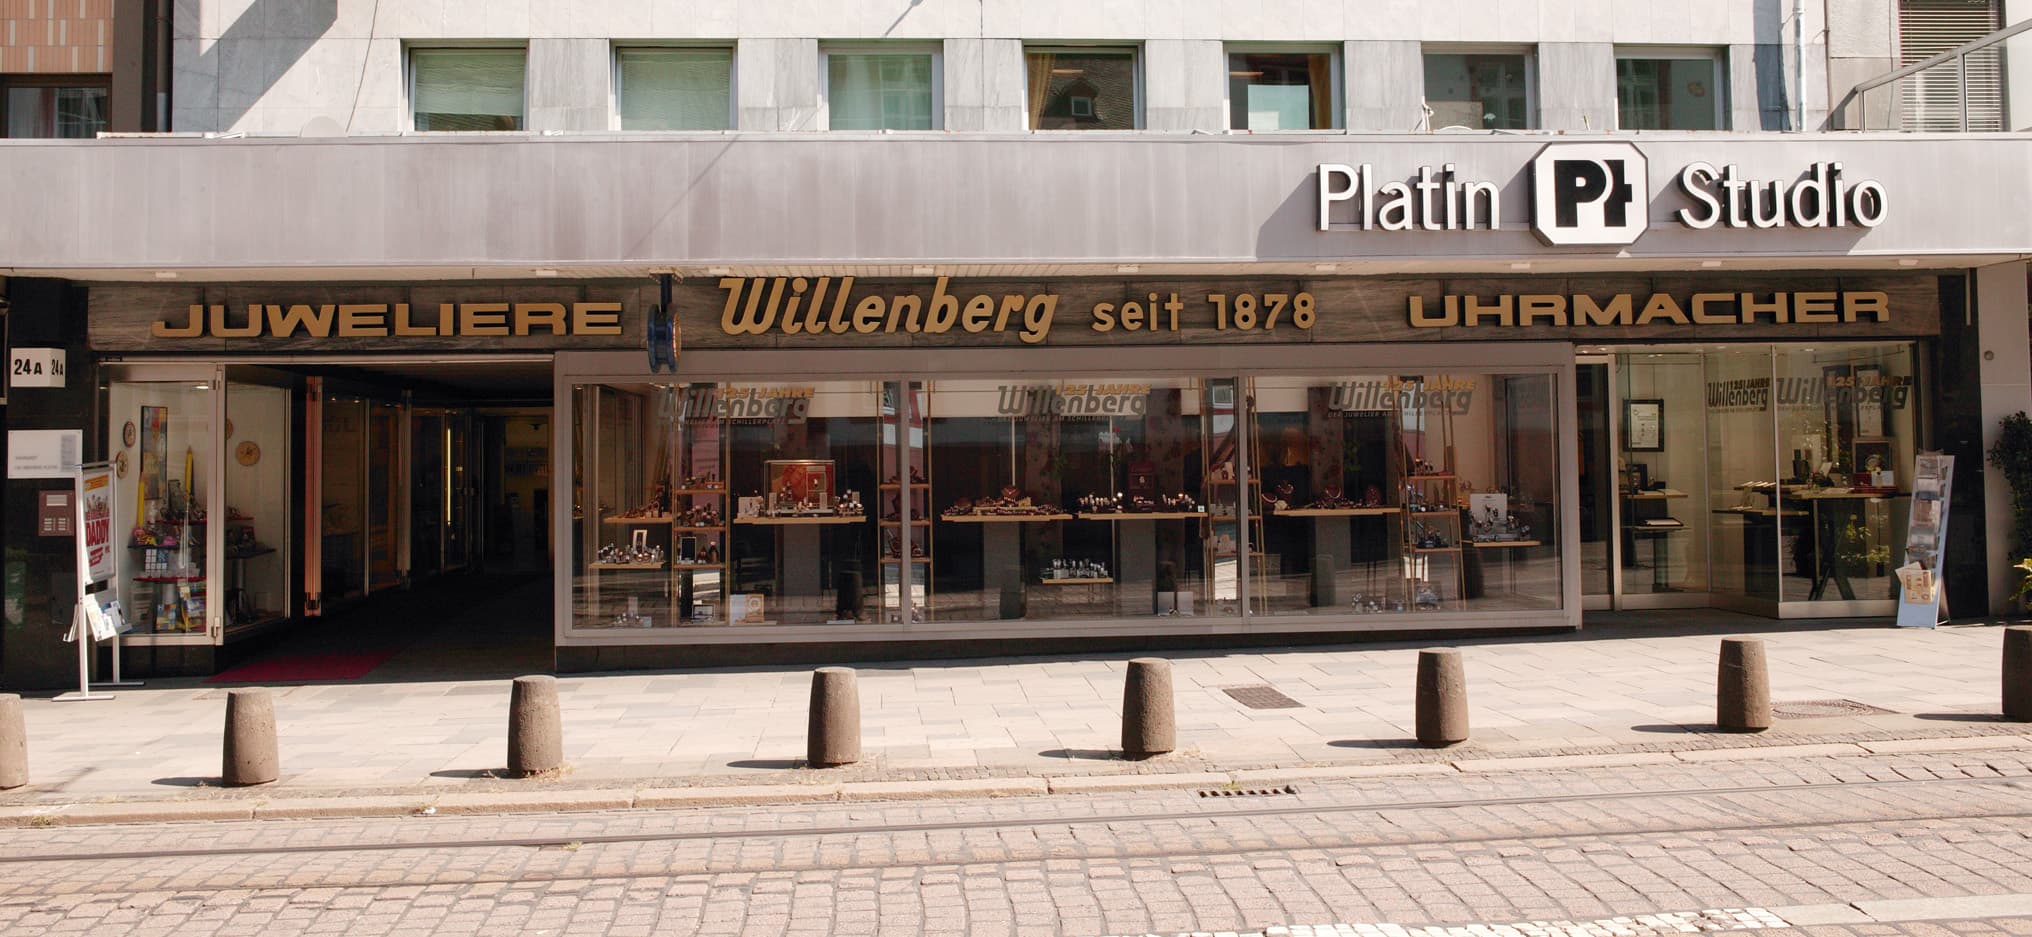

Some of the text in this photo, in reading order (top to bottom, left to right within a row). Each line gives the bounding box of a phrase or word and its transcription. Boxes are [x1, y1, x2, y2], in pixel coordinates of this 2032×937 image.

[1317, 164, 1500, 231] Platin
[1678, 161, 1889, 229] Studio
[151, 302, 624, 338] JUWELIERE
[718, 276, 1316, 344] Willenberg seit 1878
[1409, 292, 1890, 328] UHRMACHER
[657, 385, 812, 424] Willenberg
[758, 386, 816, 399] JAHRE
[998, 384, 1148, 422] Willenberg
[1055, 384, 1152, 395] 125 JAHRE
[1328, 380, 1472, 416] Willenberg
[1707, 380, 1769, 412] Willenberg
[1775, 377, 1908, 410] Willenberg
